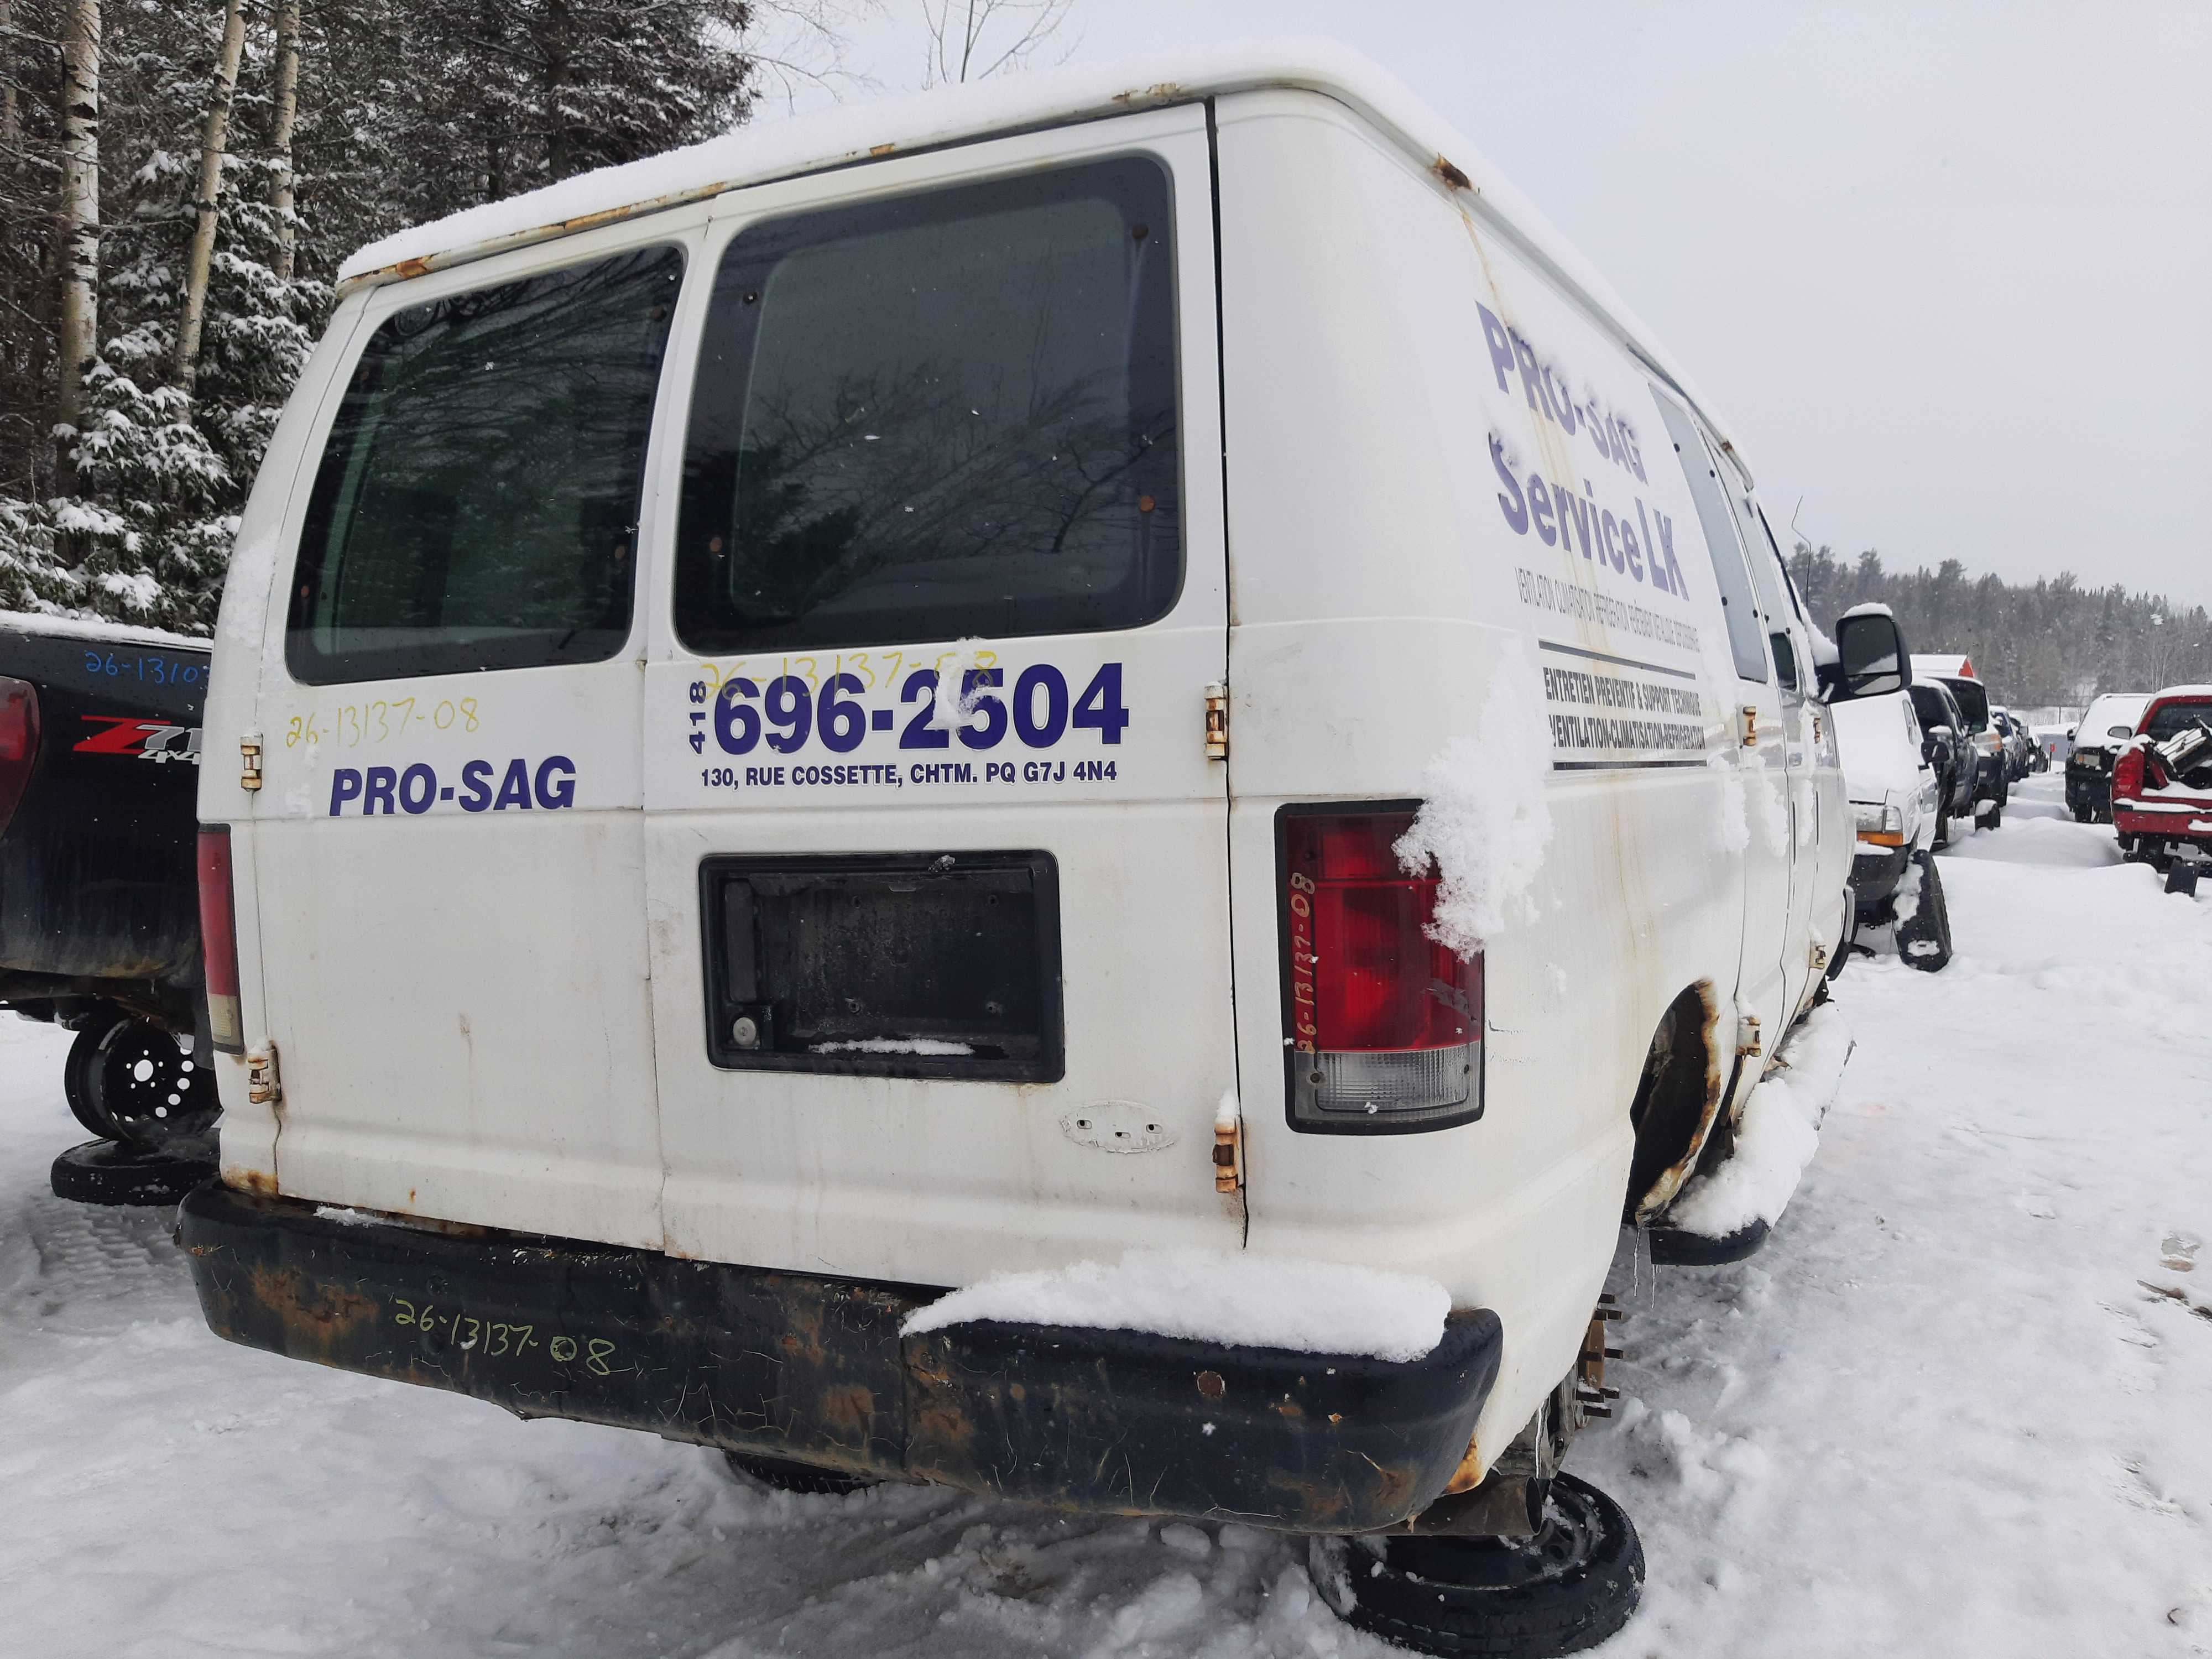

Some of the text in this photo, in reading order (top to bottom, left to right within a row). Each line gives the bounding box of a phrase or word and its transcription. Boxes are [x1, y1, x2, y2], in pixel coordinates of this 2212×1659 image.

[1488, 431, 1689, 602] Service LK
[85, 651, 211, 684] 26-1310
[1543, 666, 1595, 705] ENTRETIEN
[1594, 675, 1635, 709] PREVENTIF
[1635, 682, 1644, 710] &
[1642, 683, 1673, 714] SUPPORT
[286, 697, 480, 748] 26-13137-08
[689, 681, 706, 755] 418
[714, 662, 1129, 755] 696-2504
[330, 755, 576, 817] PRO-SAG
[701, 760, 1117, 790] 130, RUE COSSETTE, CHTM. PQ G7J 4N4
[394, 1298, 616, 1376] 26-13137-08
